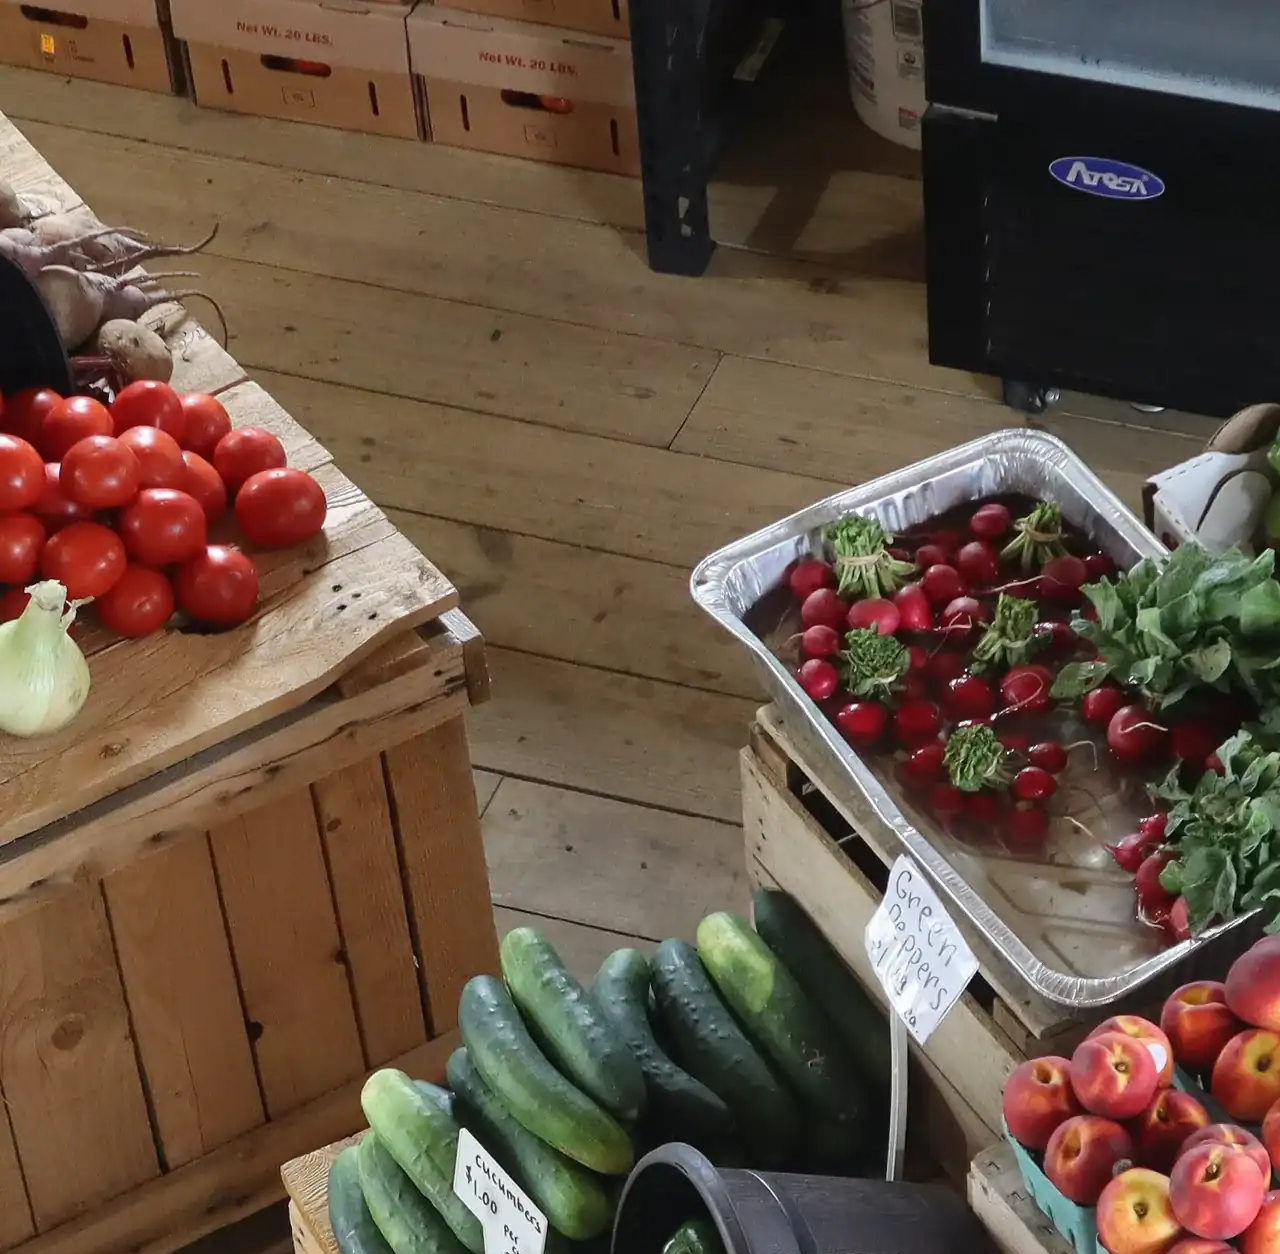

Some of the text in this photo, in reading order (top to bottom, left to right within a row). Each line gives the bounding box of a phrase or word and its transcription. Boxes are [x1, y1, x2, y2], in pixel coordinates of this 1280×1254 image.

[237, 21, 258, 34] Net
[262, 25, 281, 36] Wt.
[285, 29, 301, 41] 20
[479, 52, 501, 64] Net
[505, 56, 526, 68] Wt.
[530, 59, 545, 71] 20
[896, 870, 958, 967] Green
[465, 1165, 519, 1246] $1.00 per
